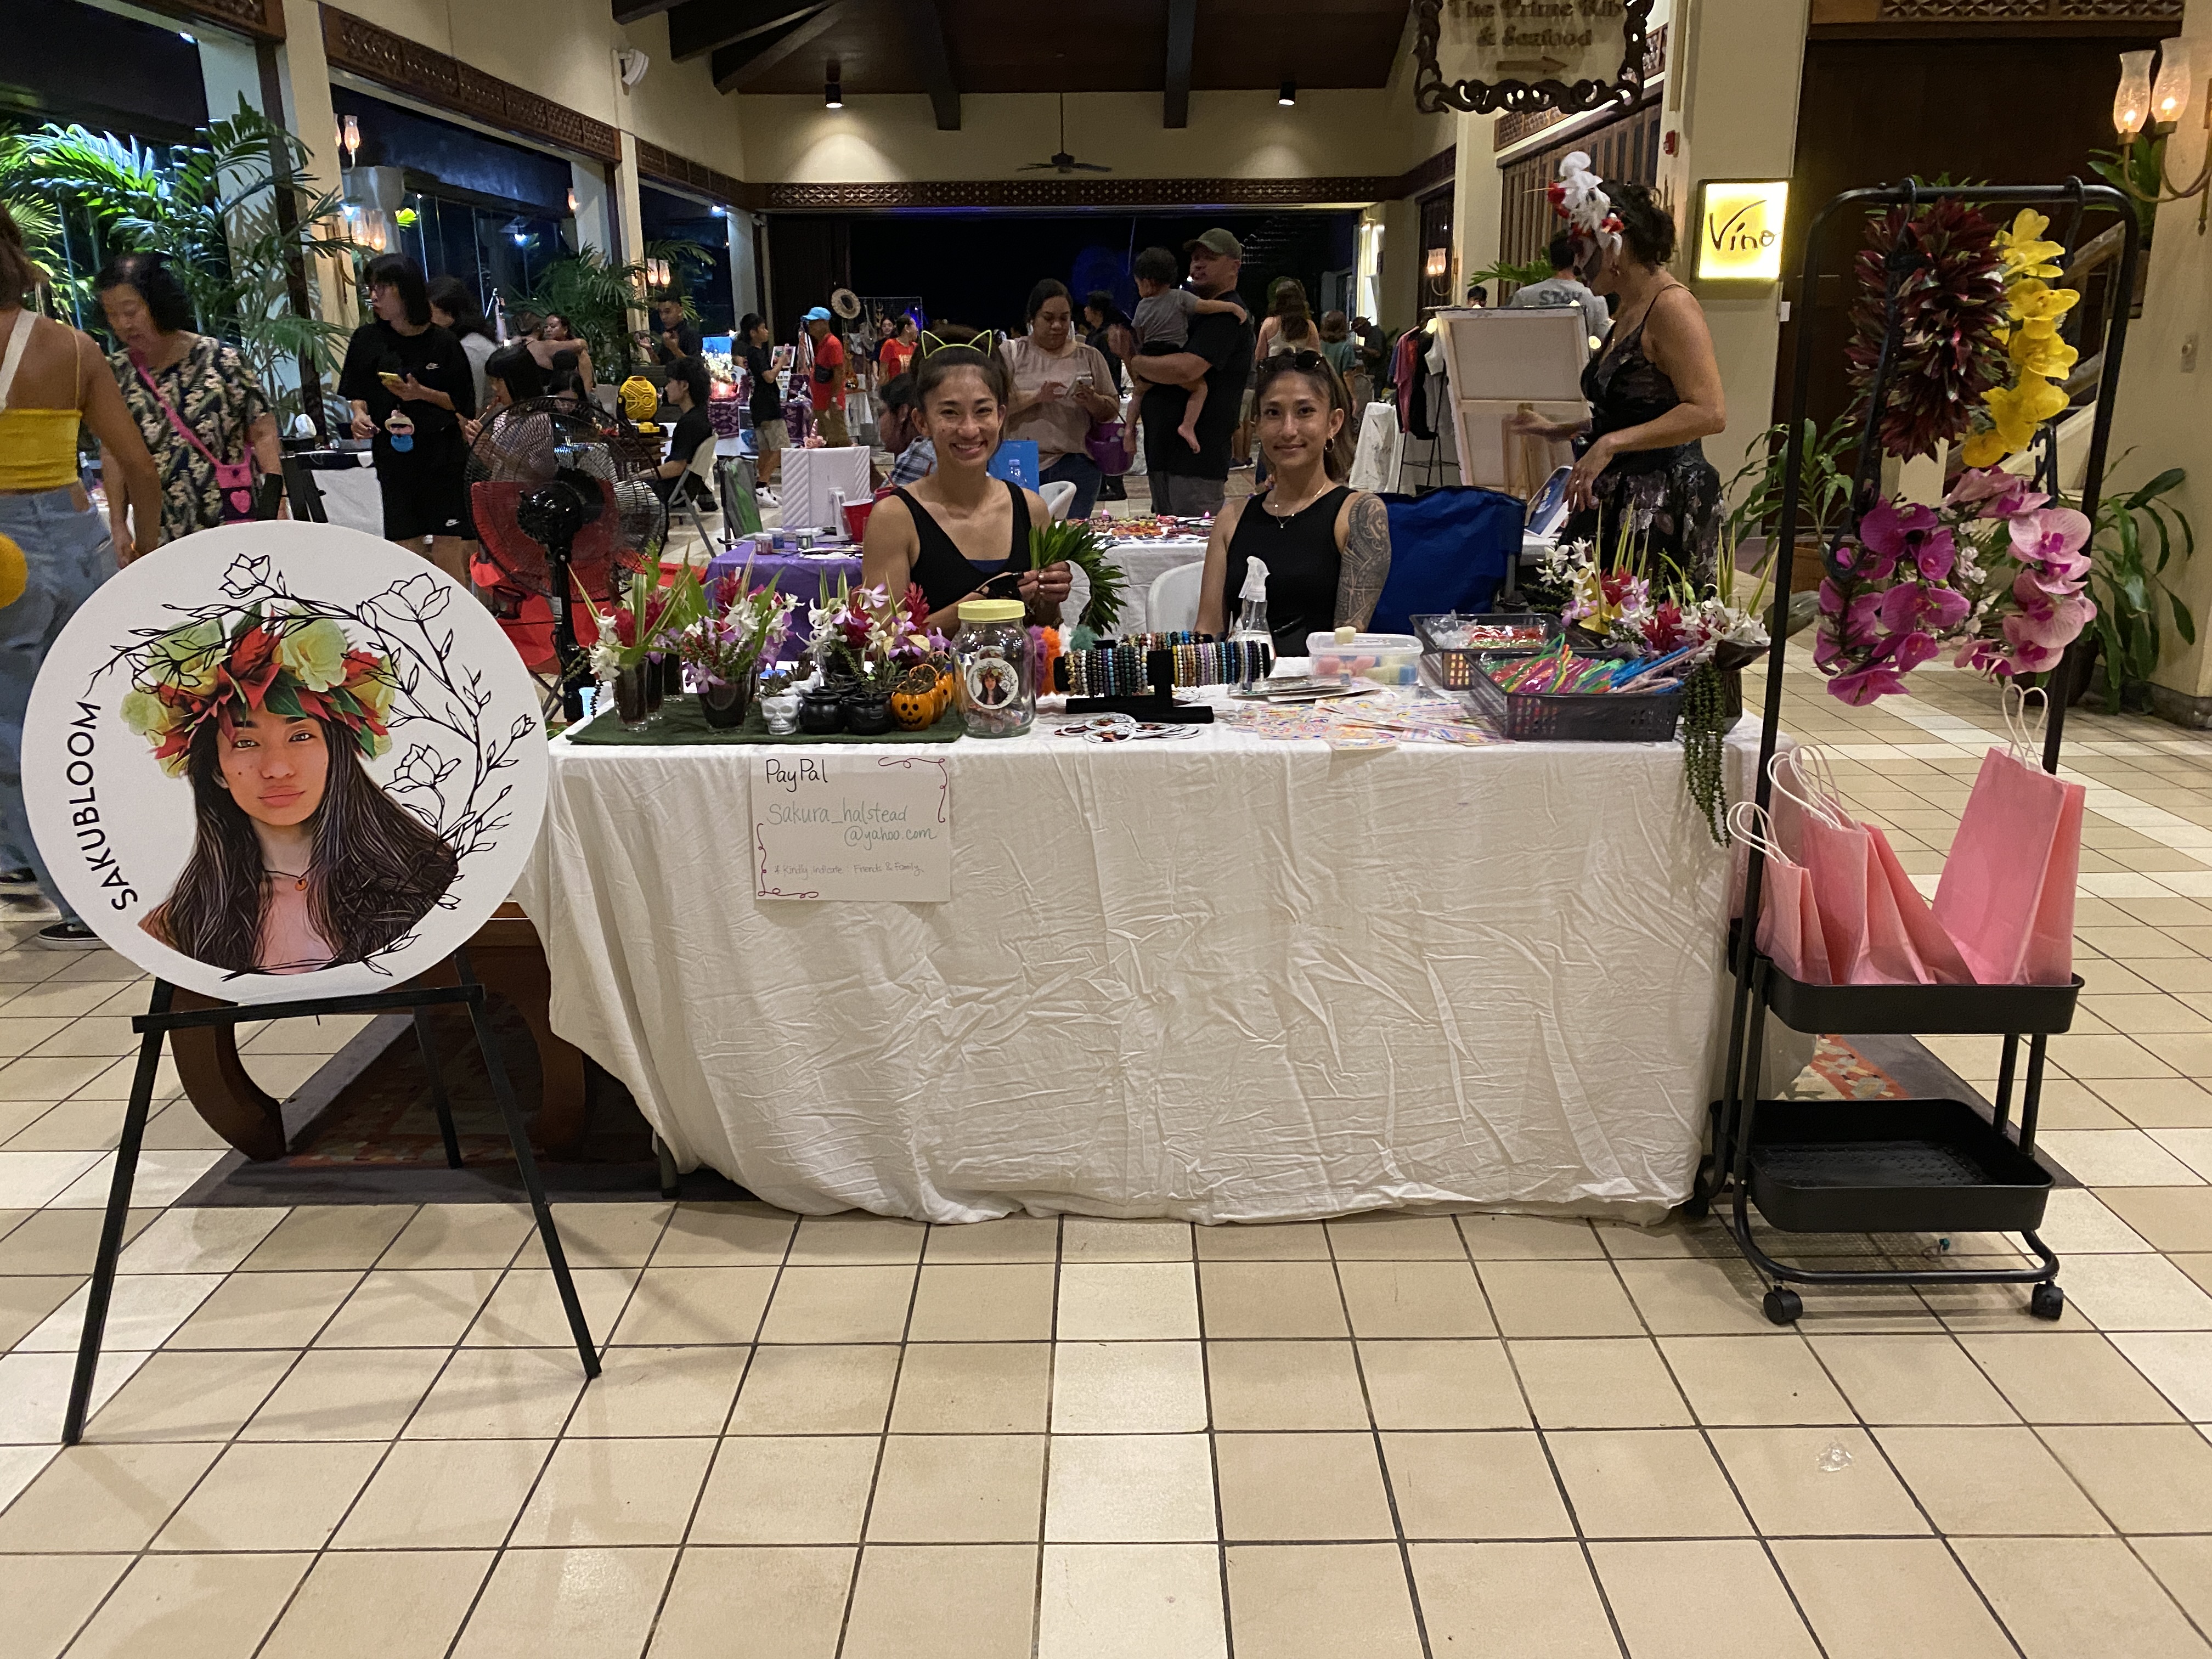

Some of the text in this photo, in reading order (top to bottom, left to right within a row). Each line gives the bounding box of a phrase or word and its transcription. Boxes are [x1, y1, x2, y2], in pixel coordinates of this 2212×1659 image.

[1709, 200, 1781, 251] Vino
[766, 759, 828, 792] PayPal
[66, 701, 138, 910] SAKUBLOOM
[844, 826, 936, 850] @yahoo.com
